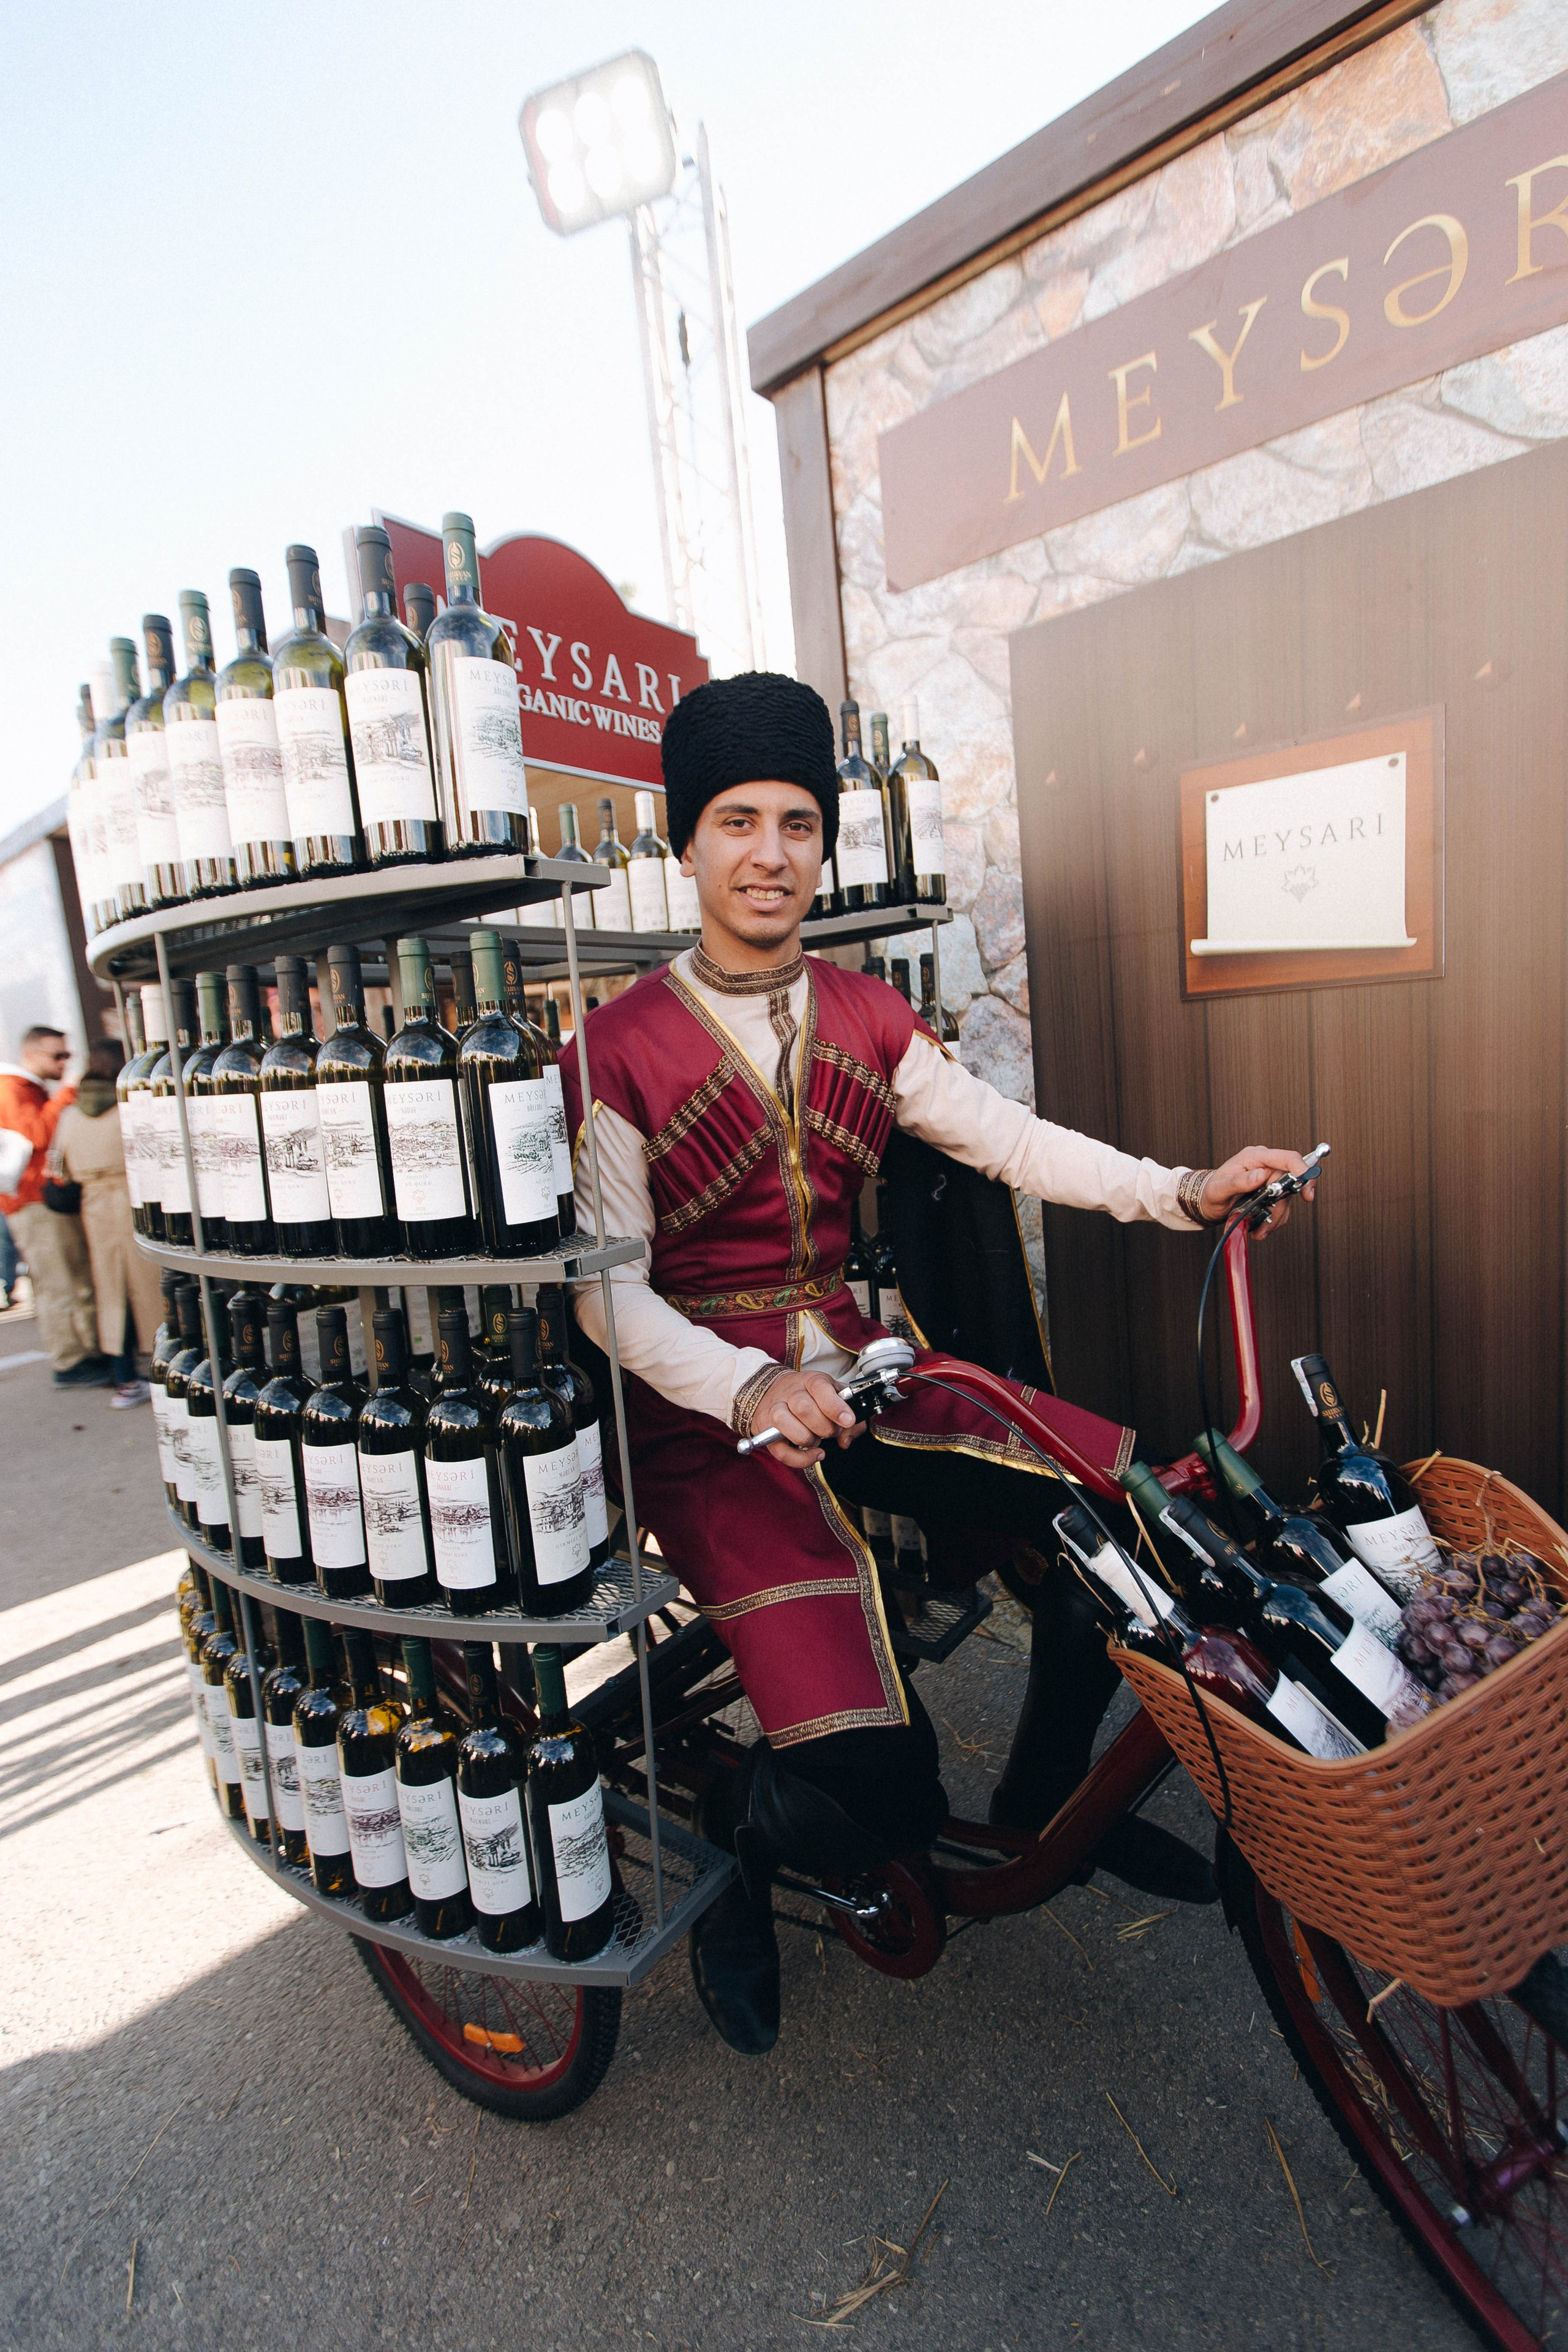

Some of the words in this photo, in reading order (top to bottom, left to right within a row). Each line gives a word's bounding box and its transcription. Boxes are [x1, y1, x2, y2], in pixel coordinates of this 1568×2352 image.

[436, 594, 682, 715] EYSARI
[518, 684, 591, 726] GANIC
[590, 706, 662, 744] WINES
[1223, 813, 1384, 861] MEYSARI
[362, 1461, 402, 1474] EYSƏRİ
